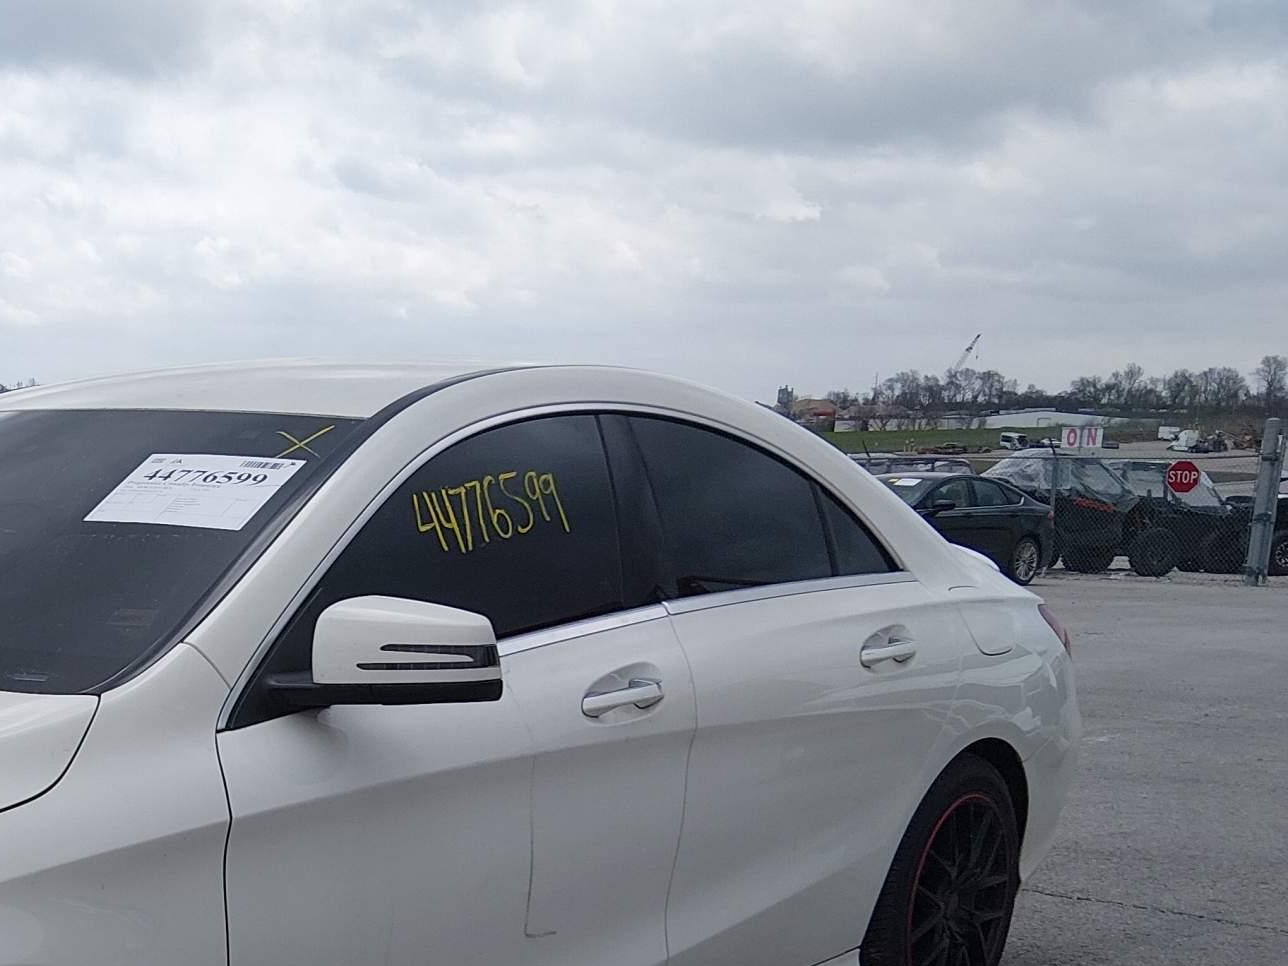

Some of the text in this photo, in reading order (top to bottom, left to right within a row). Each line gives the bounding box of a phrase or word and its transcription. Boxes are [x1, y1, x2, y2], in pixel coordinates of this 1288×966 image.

[143, 468, 269, 487] 44776599
[1168, 470, 1199, 484] STOP
[412, 471, 571, 554] 44776599
